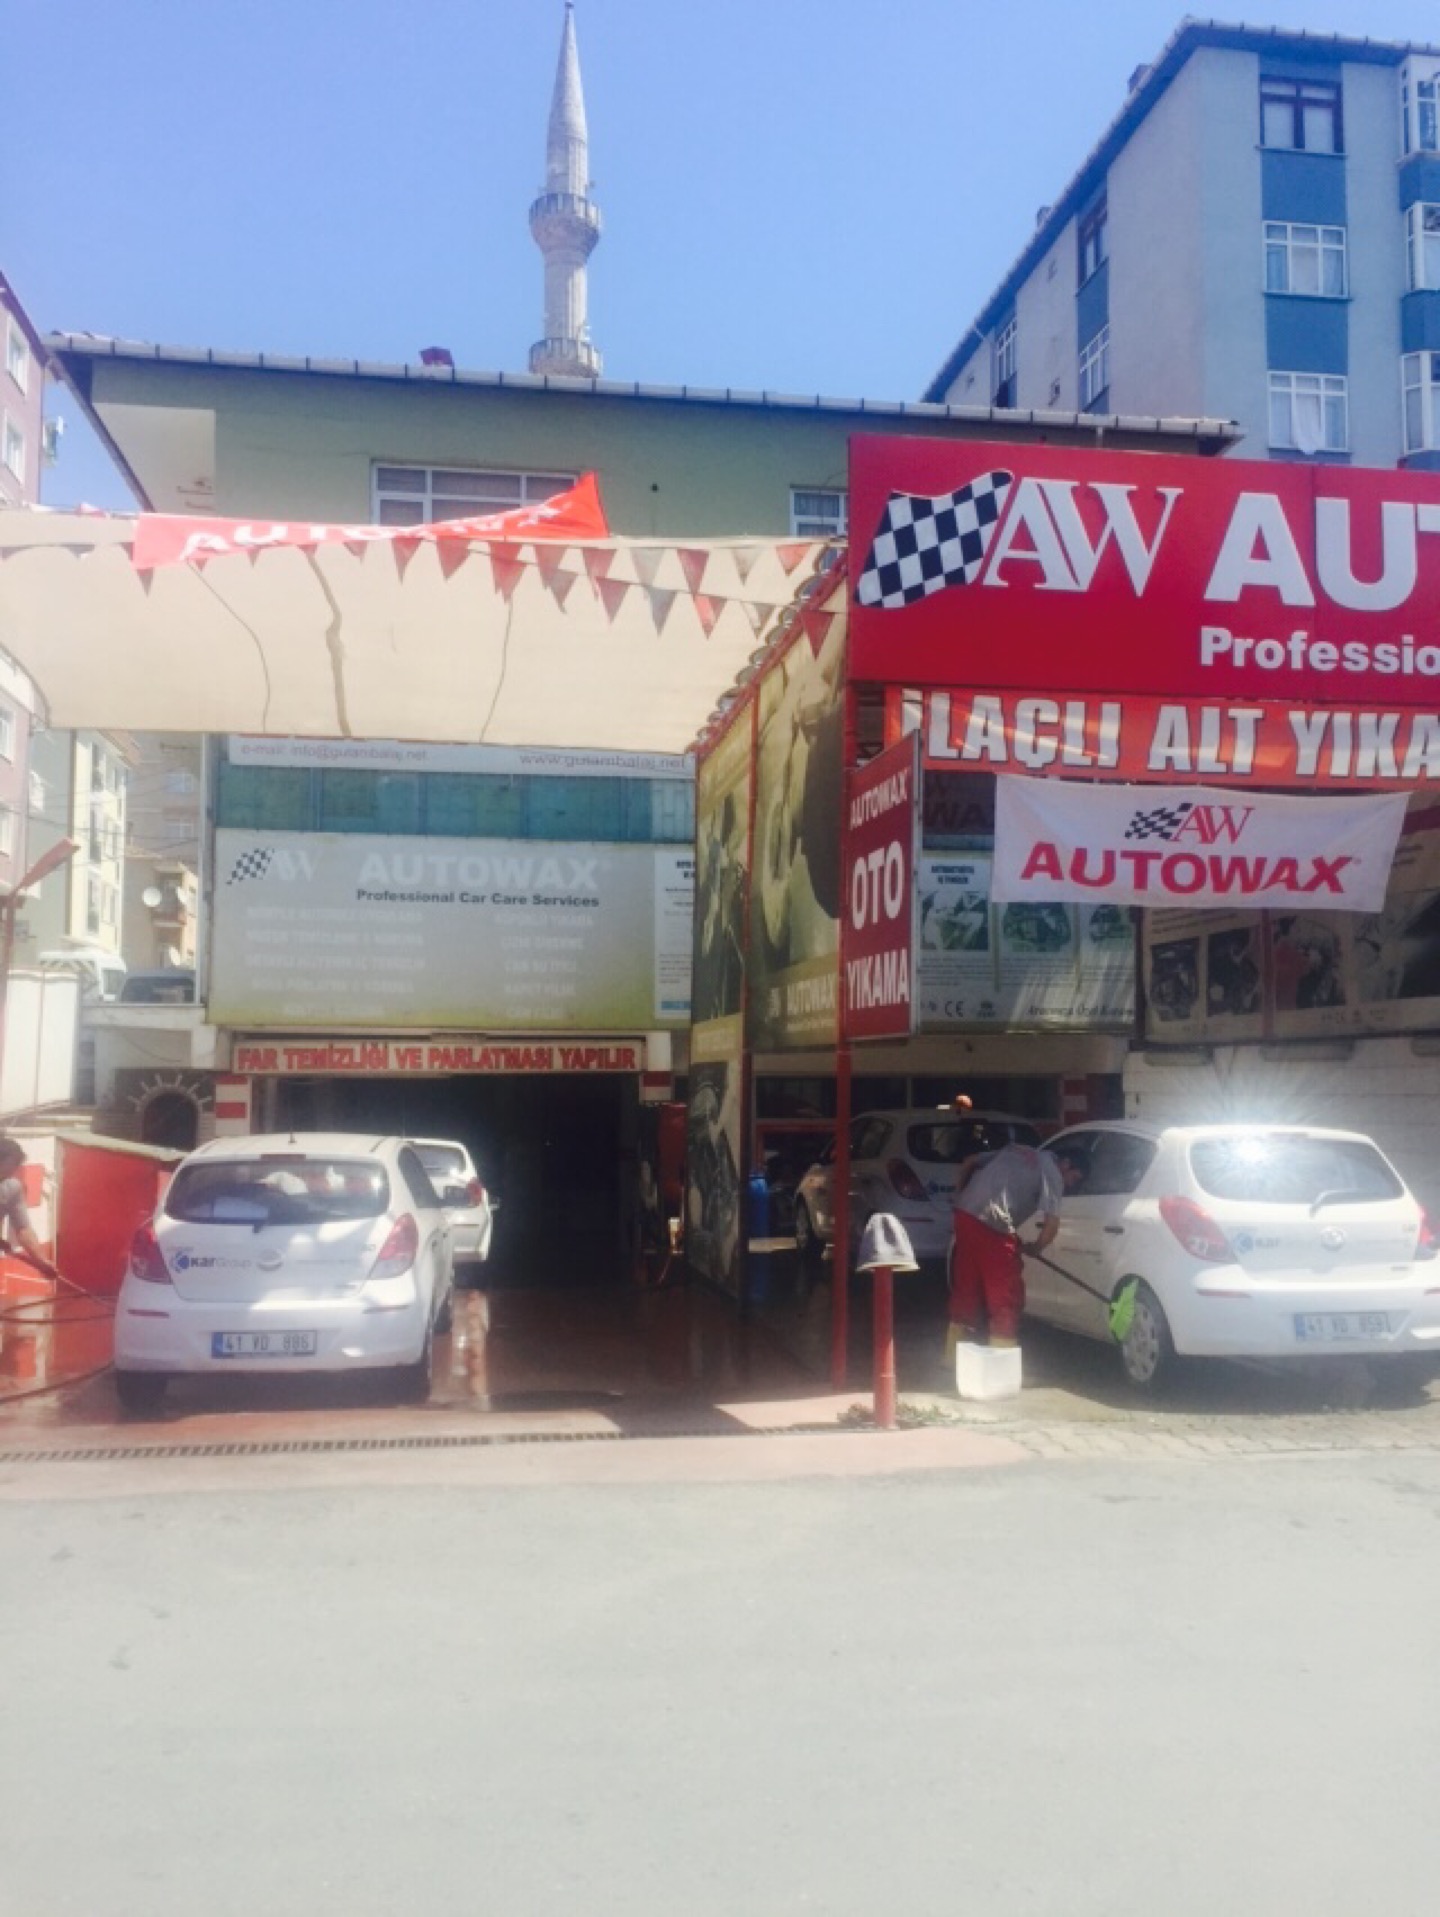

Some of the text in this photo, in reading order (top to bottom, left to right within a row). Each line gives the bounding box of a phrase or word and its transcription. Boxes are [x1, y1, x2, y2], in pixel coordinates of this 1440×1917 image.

[982, 476, 1440, 611] AW AU
[901, 687, 1440, 777] İLAÇLI ALT YIKA
[850, 768, 909, 831] AUTOWAX
[1169, 805, 1255, 844] AW
[358, 852, 599, 890] AUTOWAX
[852, 840, 904, 930] OTO
[1020, 841, 1352, 894] AUTOWAX
[356, 888, 600, 908] Professional Car Care Services
[848, 948, 910, 1010] YIKAMA
[238, 1041, 636, 1070] FAR TEMİZLİĞİ VE PARLATMASI YAPILIR
[224, 1335, 243, 1351] 41
